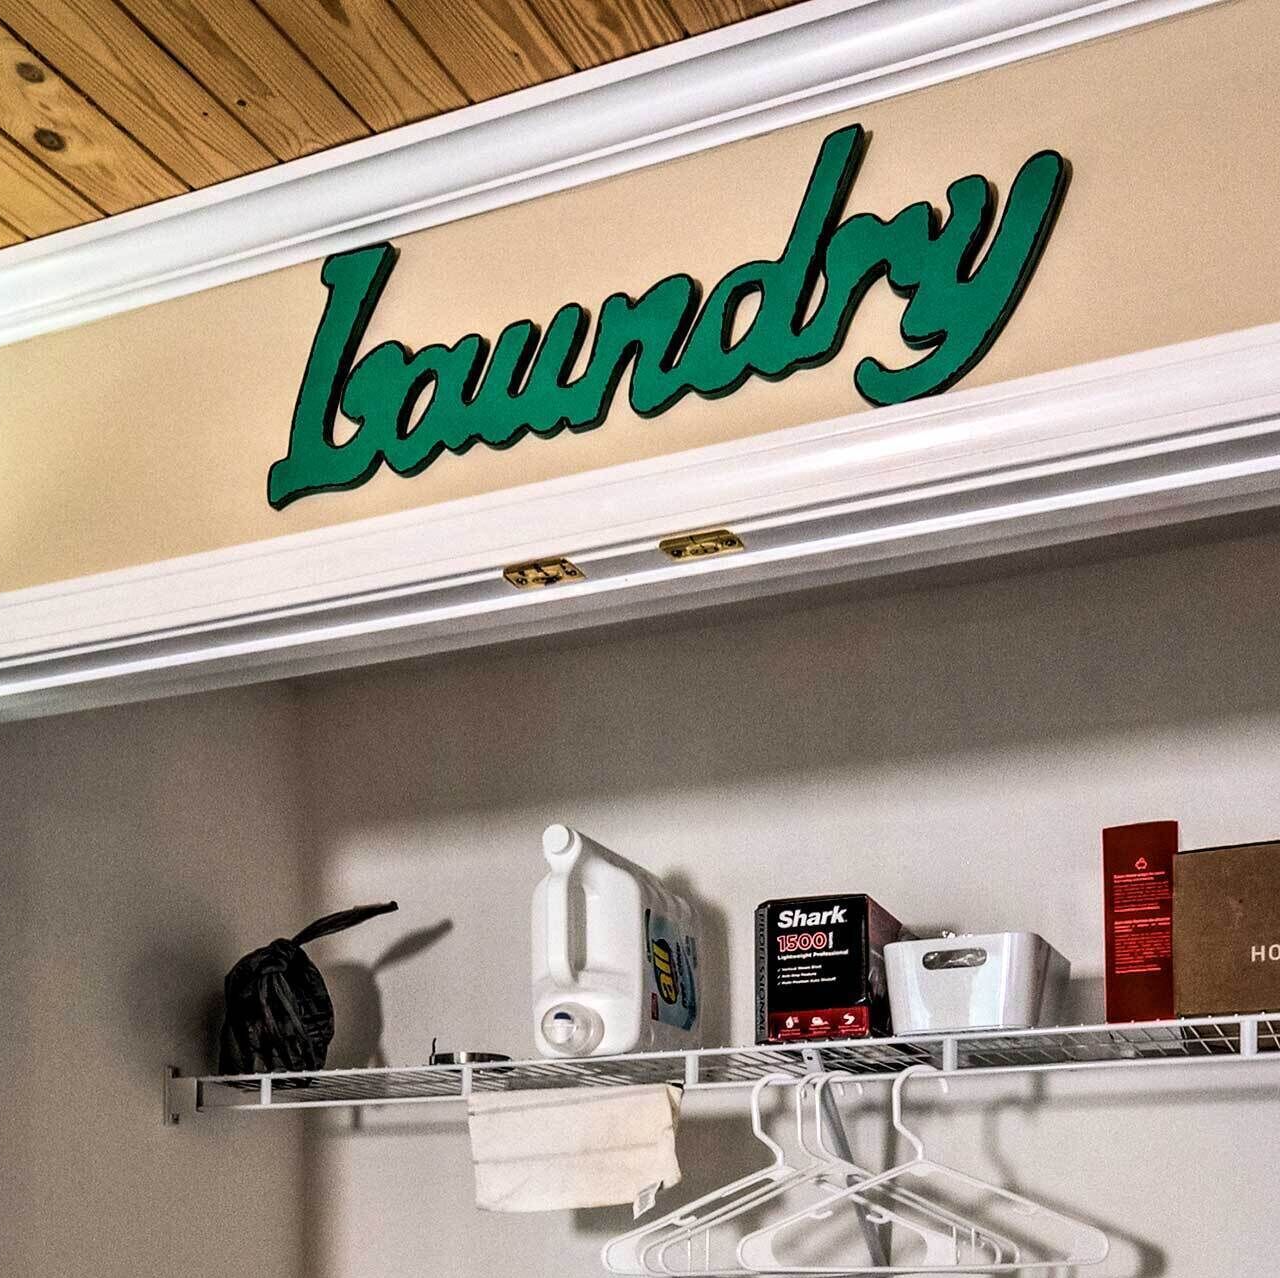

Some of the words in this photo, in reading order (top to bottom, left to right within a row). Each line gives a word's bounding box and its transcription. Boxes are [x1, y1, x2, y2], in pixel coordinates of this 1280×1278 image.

[267, 124, 1068, 511] Laundry
[777, 905, 848, 929] Shark
[777, 931, 828, 953] 1500
